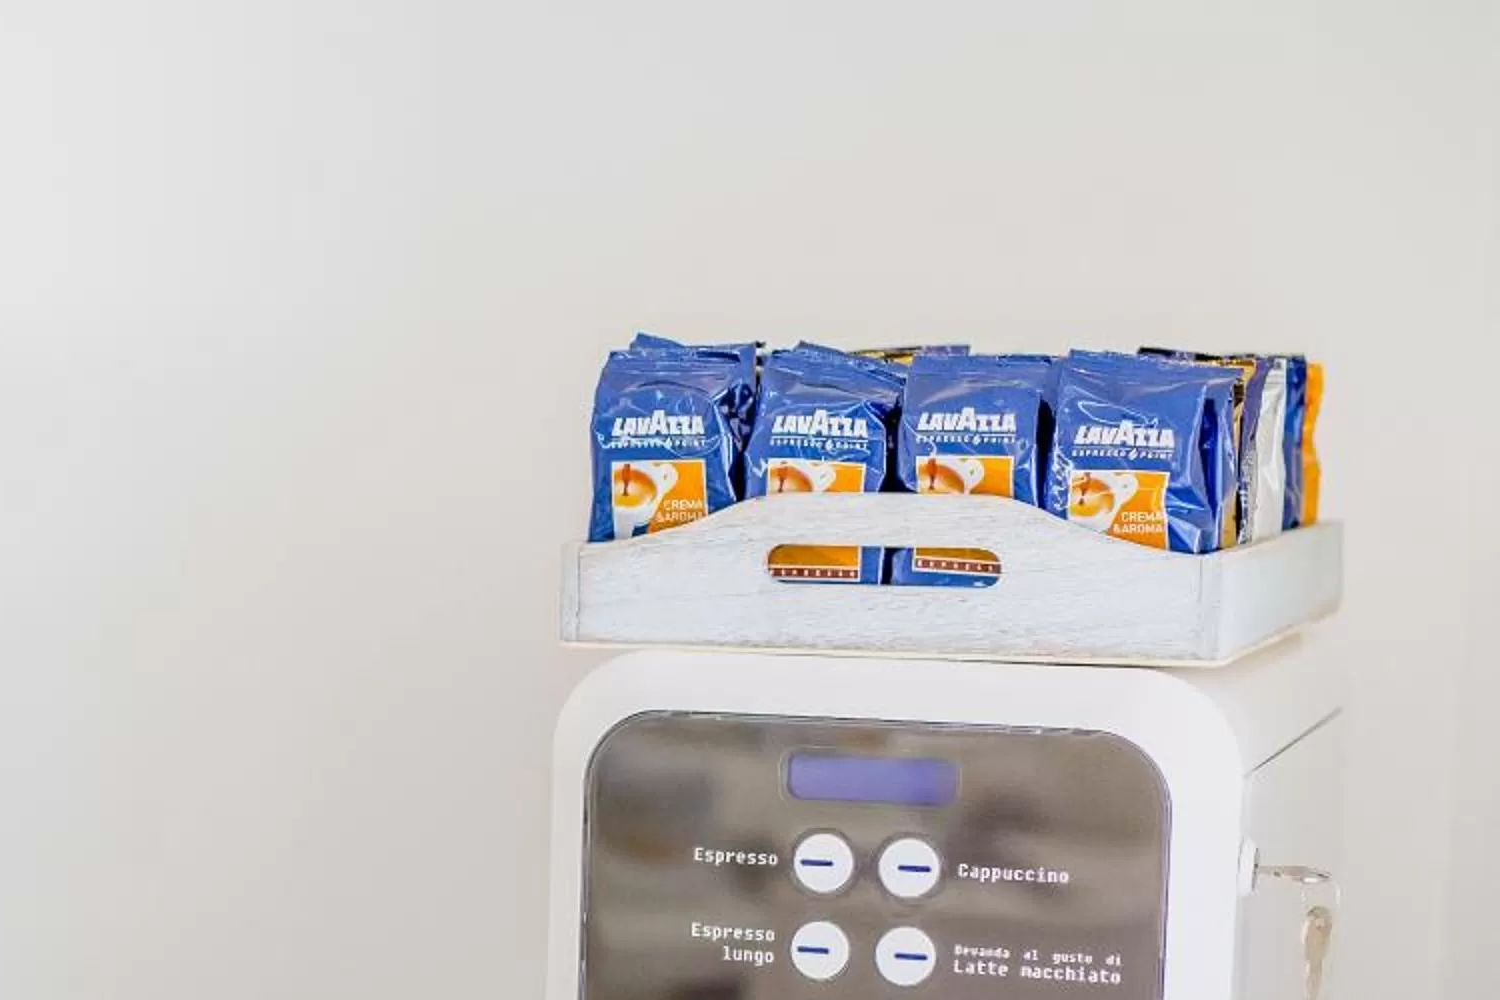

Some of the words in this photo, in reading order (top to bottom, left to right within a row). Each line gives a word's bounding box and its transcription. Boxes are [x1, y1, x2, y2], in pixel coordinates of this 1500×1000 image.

[611, 409, 705, 437] LAVAZZA
[771, 409, 869, 438] LAVAZZA
[917, 407, 1017, 433] LAVAZZA
[1073, 419, 1175, 447] LAVAZZA
[1121, 511, 1162, 522] CREMA
[694, 846, 779, 866] Espresso
[957, 863, 1070, 883] Cappuccino
[691, 922, 776, 942] Espresso
[723, 945, 775, 966] lungo
[1023, 949, 1039, 961] al
[1052, 951, 1093, 965] gusto
[1105, 953, 1122, 966] di
[953, 960, 1009, 977] Latte
[1020, 965, 1122, 985] macchiato
